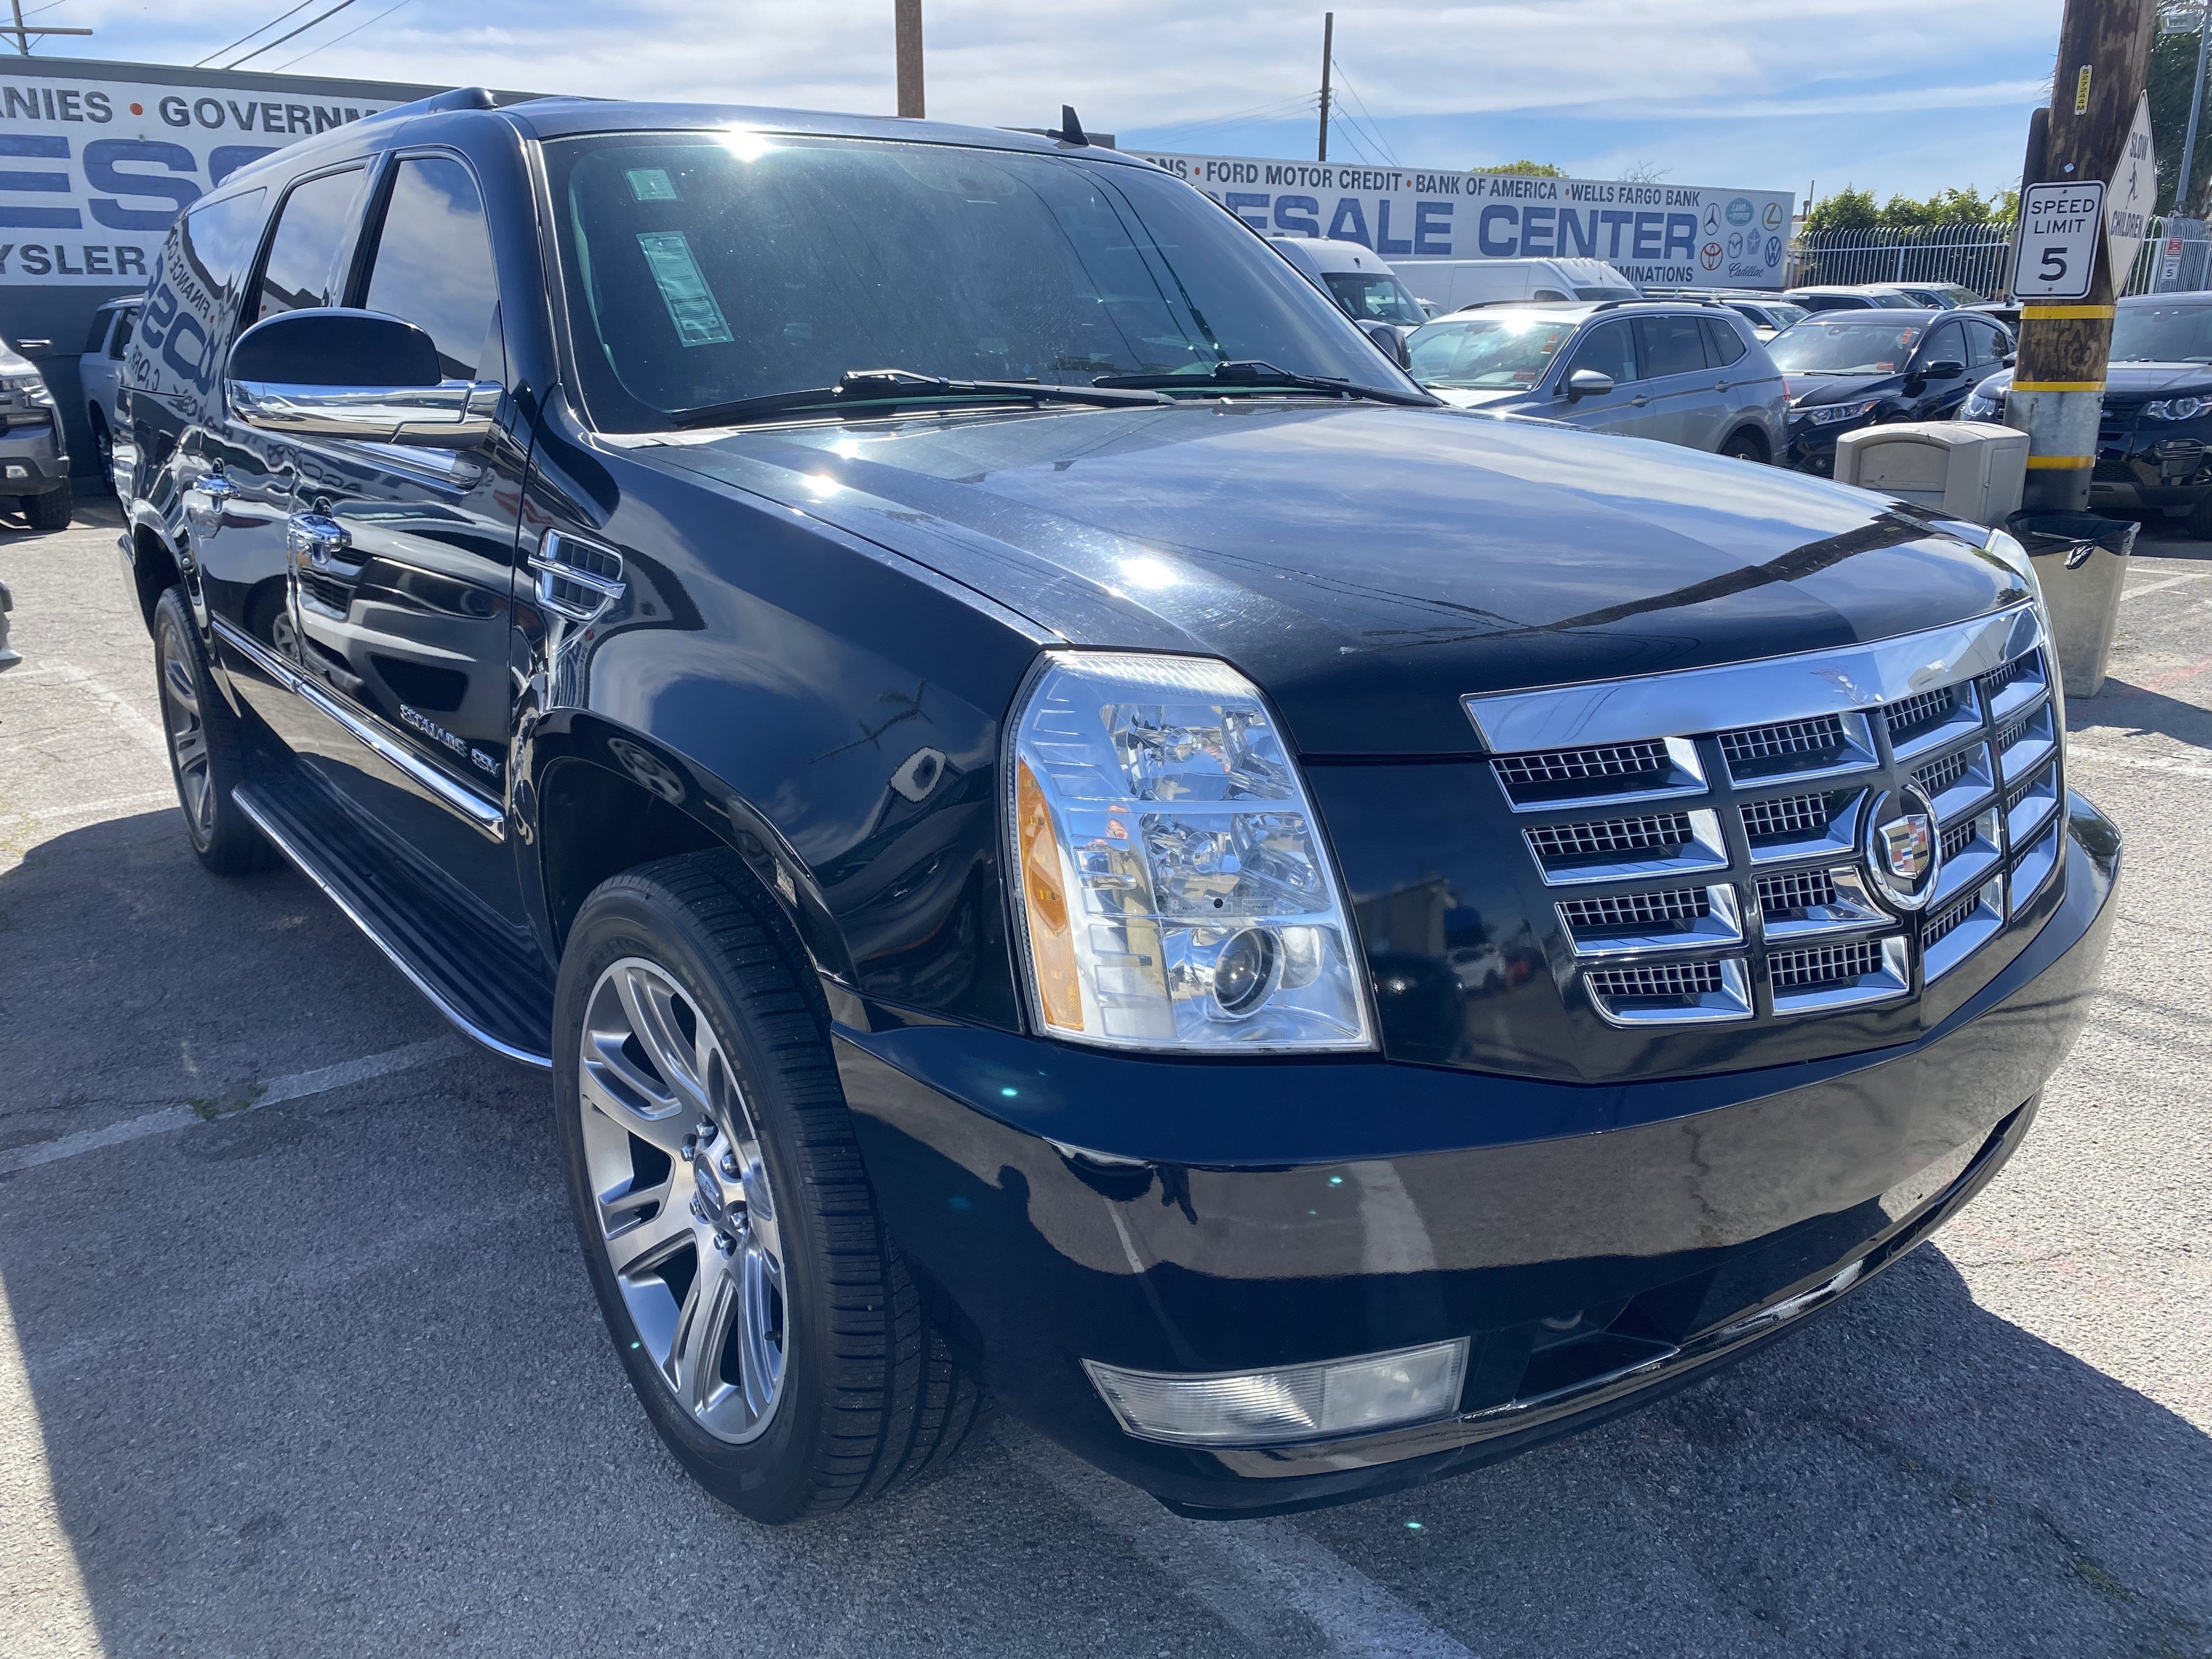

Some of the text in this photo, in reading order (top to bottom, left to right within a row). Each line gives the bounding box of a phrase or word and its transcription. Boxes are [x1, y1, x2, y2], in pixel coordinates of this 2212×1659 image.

[0, 86, 113, 123] NIES
[2130, 132, 2149, 161] SLOW
[1206, 161, 1259, 183] FORD
[1266, 165, 1333, 188] MOTOR
[1339, 170, 1403, 191] CREDIT
[1416, 174, 1461, 194] BANK
[1466, 177, 1487, 196] OF
[1489, 179, 1558, 200] AMERICA
[1571, 184, 1615, 202] WELLS
[1618, 188, 1662, 205] FARGO
[1666, 190, 1701, 207] BANK
[2031, 199, 2095, 215] SPEED
[1479, 204, 1698, 259] CENTER
[2034, 219, 2086, 234] LIMIT
[2111, 210, 2145, 239] CHILDREN
[1612, 266, 1694, 282] MINATIONS
[1729, 263, 1764, 278] Cadillac
[2038, 247, 2068, 281] 5
